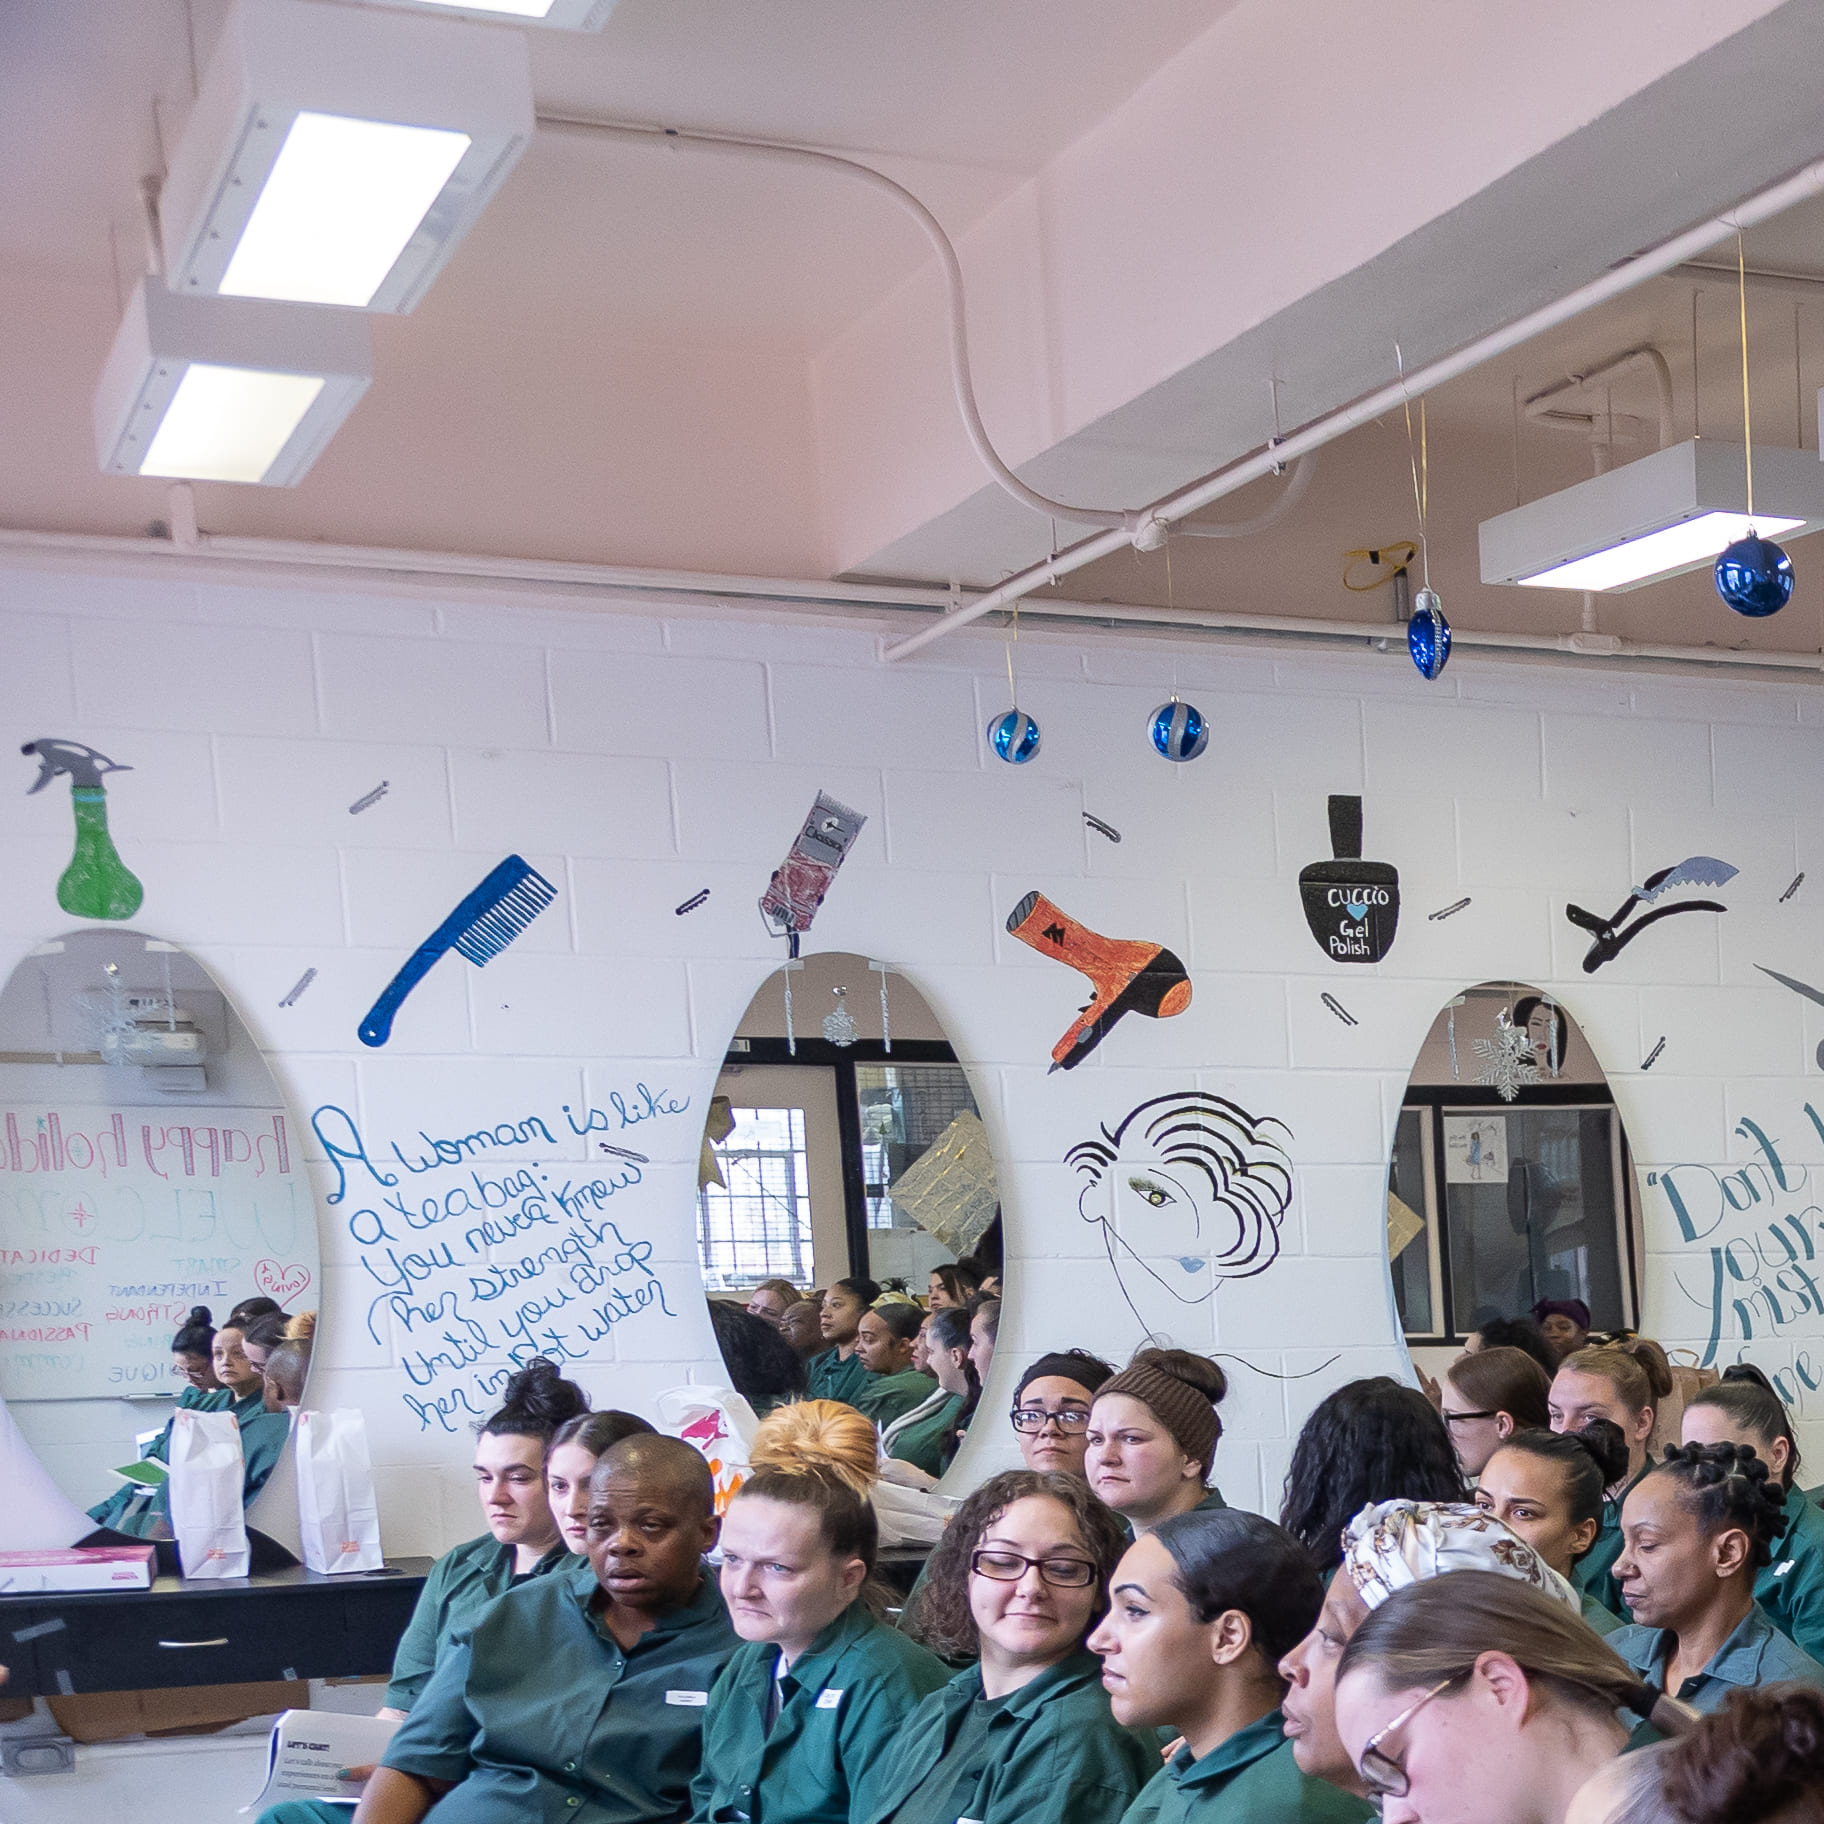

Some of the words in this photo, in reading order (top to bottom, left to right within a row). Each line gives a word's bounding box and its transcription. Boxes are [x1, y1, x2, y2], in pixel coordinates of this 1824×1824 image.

[1330, 936, 1370, 956] Polish
[1340, 917, 1368, 938] Gel
[312, 1104, 400, 1205] A
[563, 1105, 609, 1136] is
[611, 1083, 692, 1129] like
[471, 1222, 633, 1301] strength
[498, 1290, 576, 1341] you
[570, 1240, 654, 1297] drop
[403, 1387, 485, 1433] her
[474, 1371, 511, 1397] in
[578, 1279, 679, 1343] water
